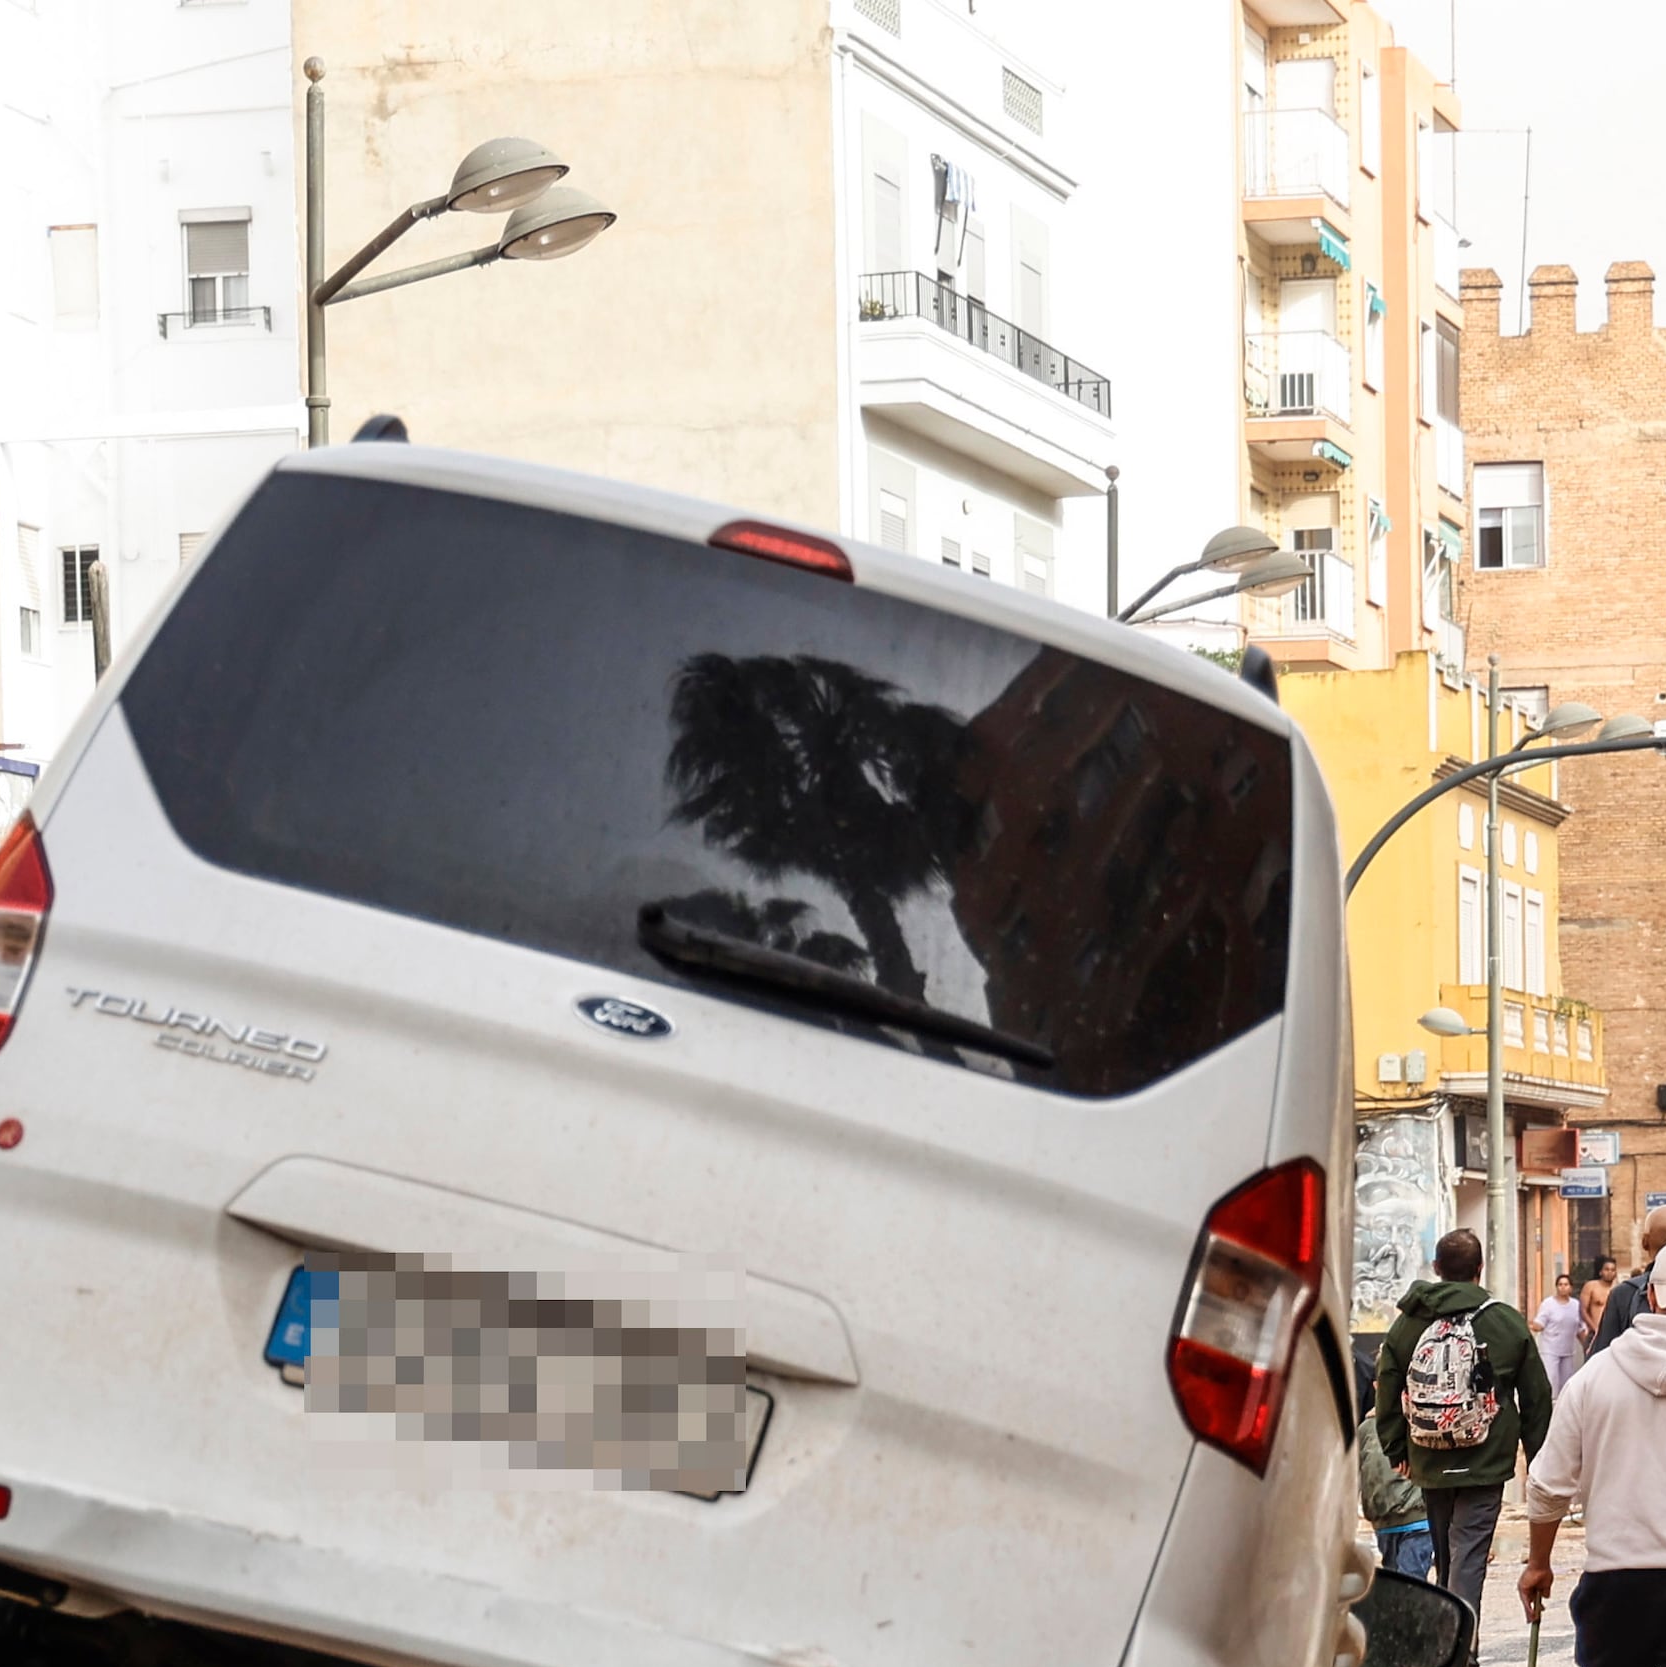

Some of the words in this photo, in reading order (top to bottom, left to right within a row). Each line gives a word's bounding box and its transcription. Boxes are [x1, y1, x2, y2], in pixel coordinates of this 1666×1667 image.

[66, 985, 328, 1062] TOURNEO
[592, 998, 657, 1036] Ford
[153, 1033, 317, 1083] COURIER
